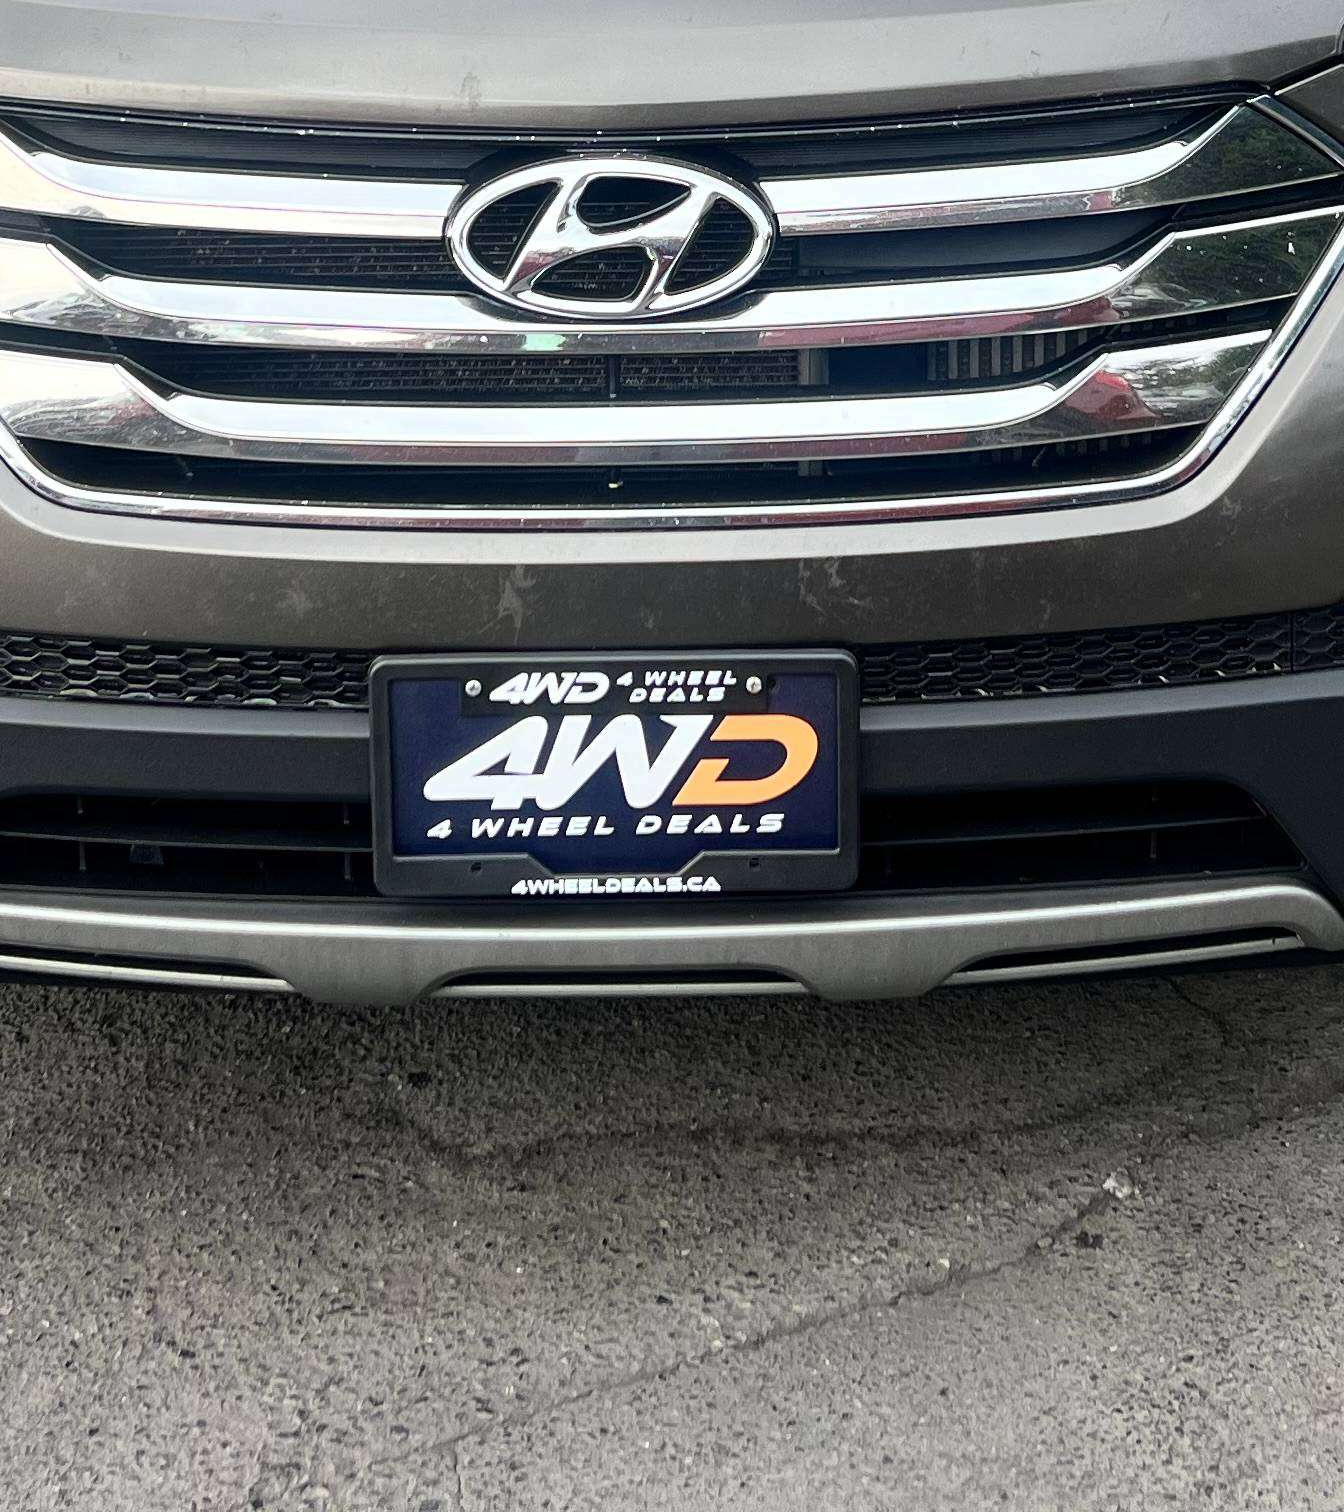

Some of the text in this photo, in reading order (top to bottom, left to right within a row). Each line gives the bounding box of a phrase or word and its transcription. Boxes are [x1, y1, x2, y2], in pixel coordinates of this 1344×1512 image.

[489, 672, 610, 704] 4WD
[616, 670, 737, 686] 4 WHEEL
[629, 687, 725, 703] DEALS
[423, 714, 818, 810] 4WD
[427, 813, 784, 838] 4 WHEEL DEALS
[511, 876, 721, 895] 4WHEELDEALS.CA
